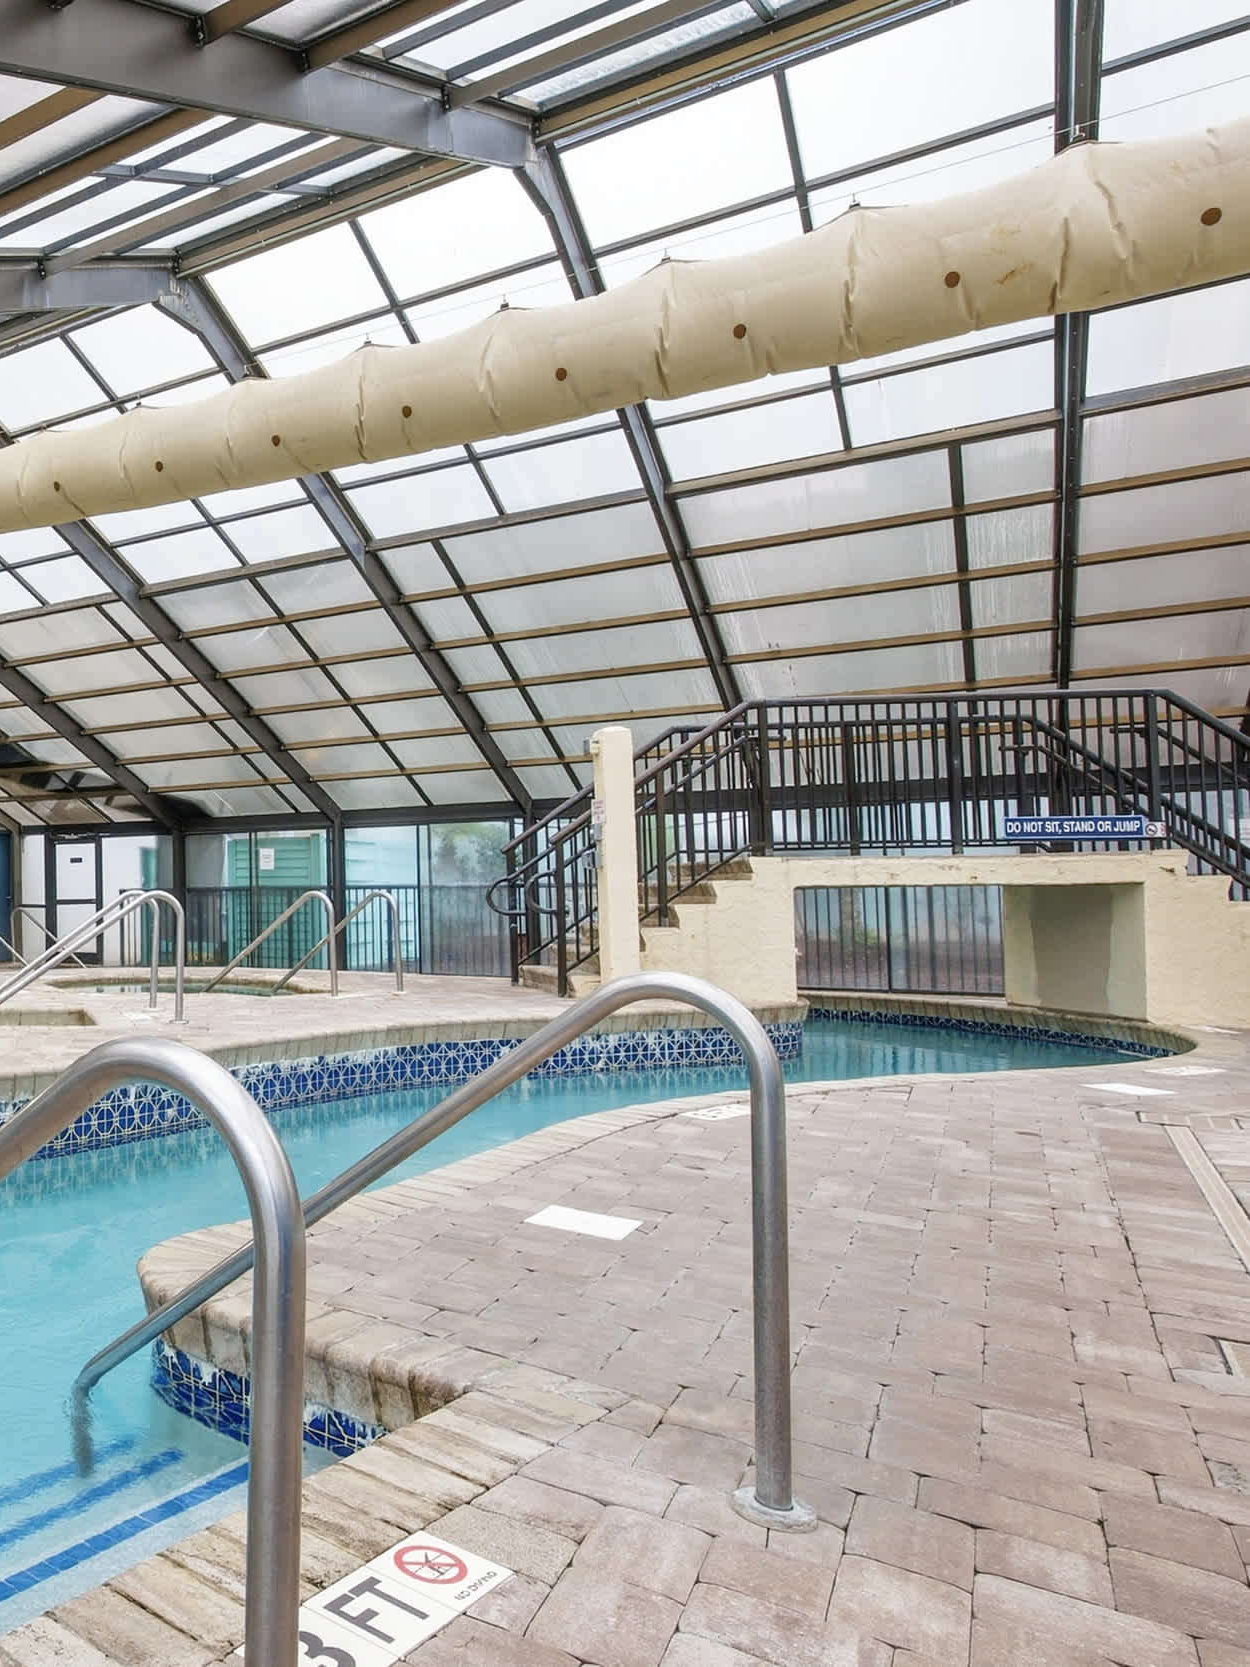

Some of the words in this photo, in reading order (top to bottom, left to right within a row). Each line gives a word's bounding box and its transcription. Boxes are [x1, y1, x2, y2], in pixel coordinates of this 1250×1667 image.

[1006, 822, 1021, 833] DO
[1023, 822, 1043, 833] NOT
[1045, 821, 1062, 834] SIT,
[1063, 821, 1095, 832] STAND
[1097, 821, 1111, 832] OR
[1113, 820, 1140, 832] JUMP
[453, 1590, 471, 1601] NO
[322, 1575, 430, 1645] FT
